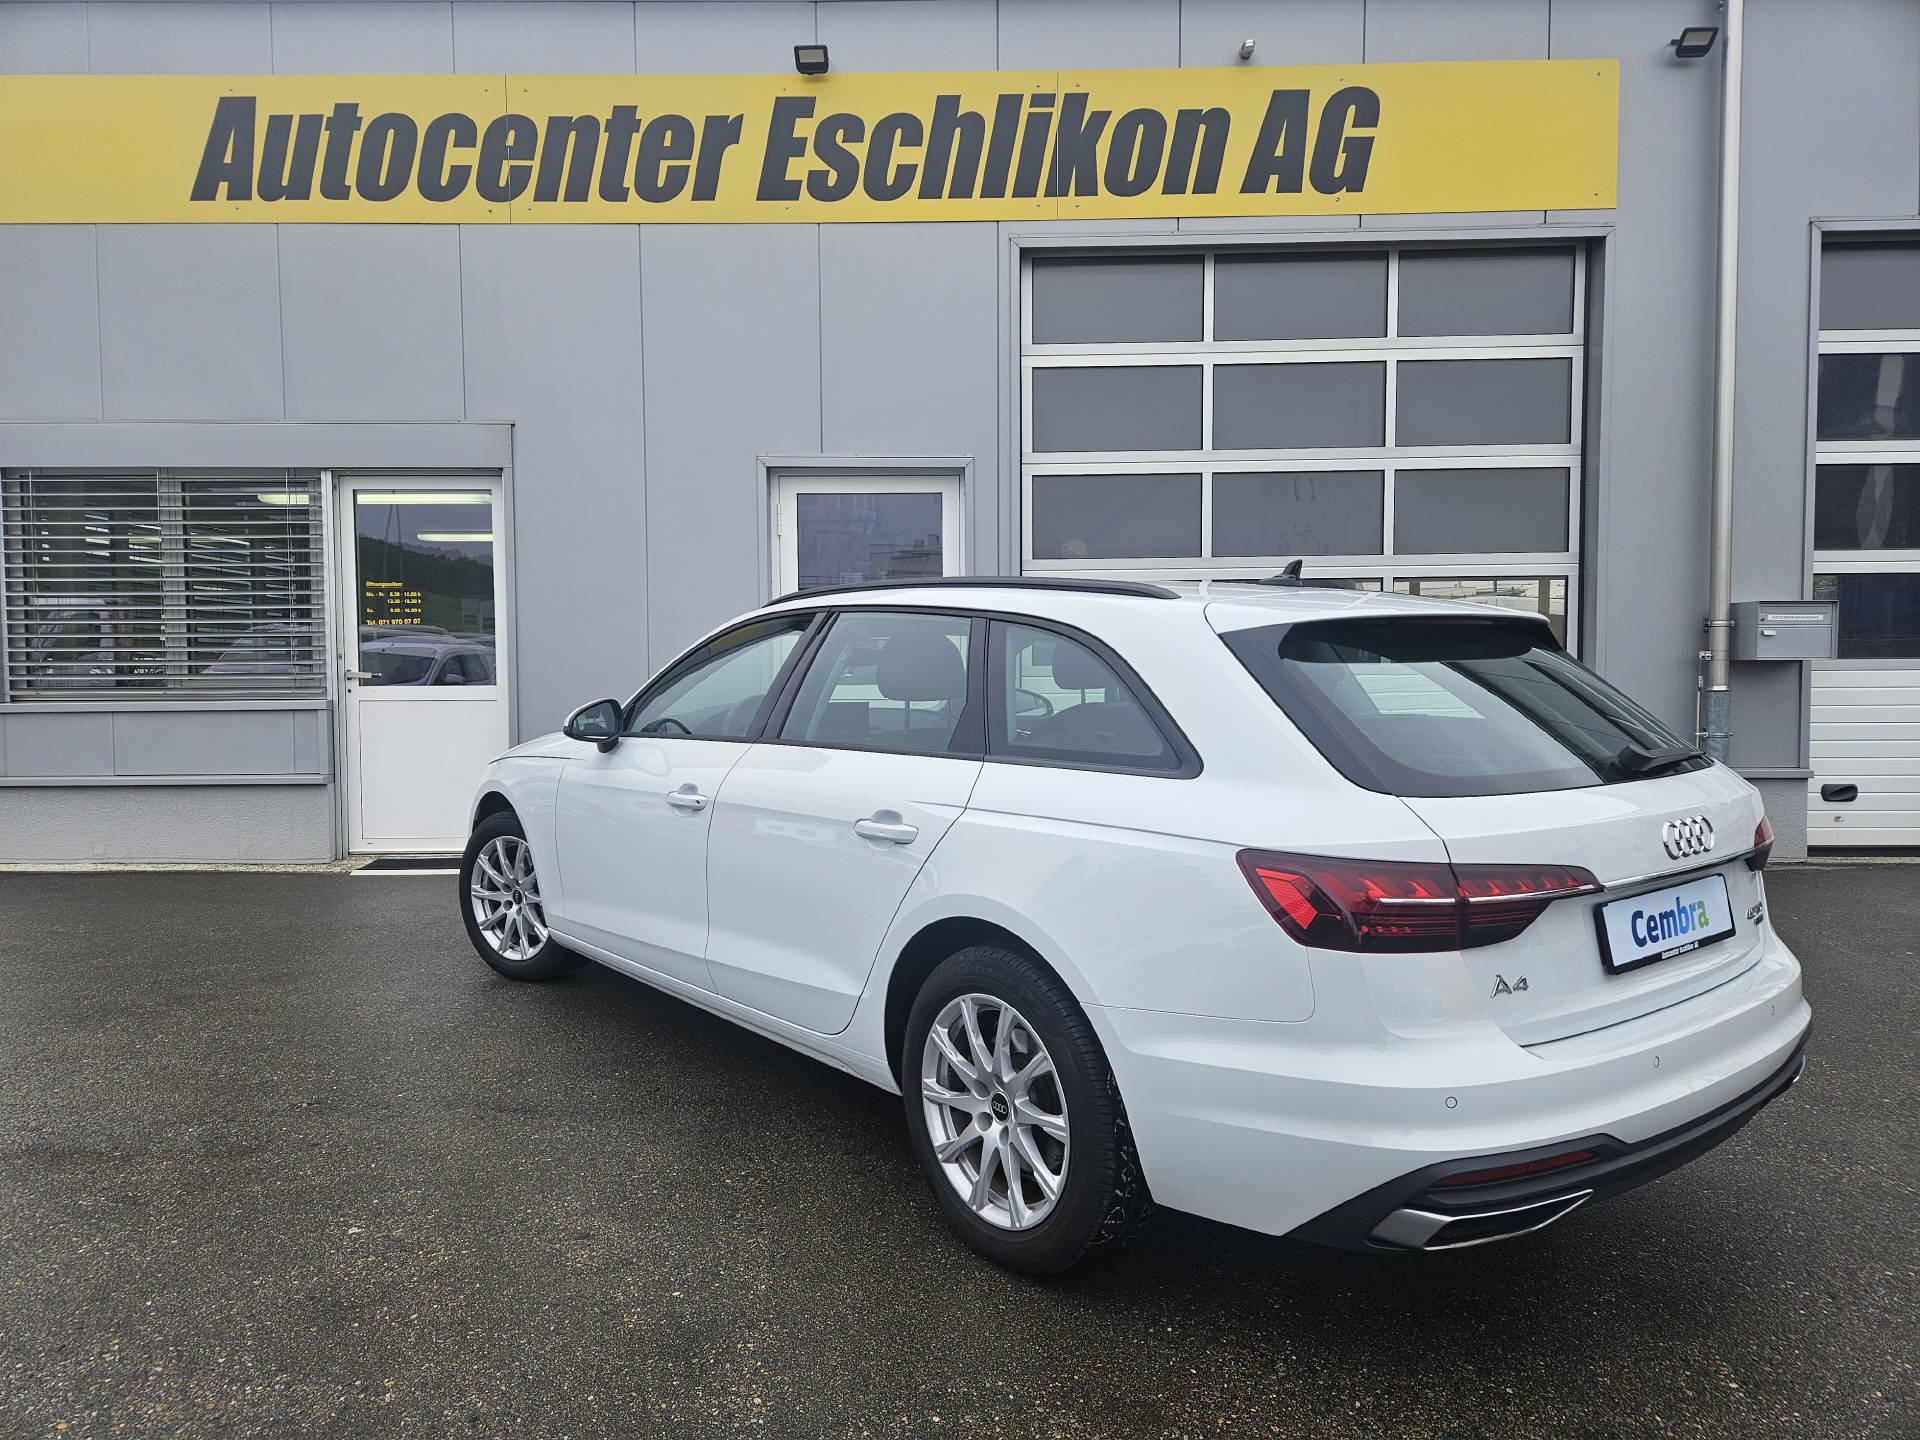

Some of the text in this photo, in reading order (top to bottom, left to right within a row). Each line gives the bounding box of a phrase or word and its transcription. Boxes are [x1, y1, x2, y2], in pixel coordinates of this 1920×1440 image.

[190, 86, 1381, 204] Autocenter Eschlikon AG
[1631, 896, 1710, 948] Cembra
[1490, 974, 1530, 998] A4
